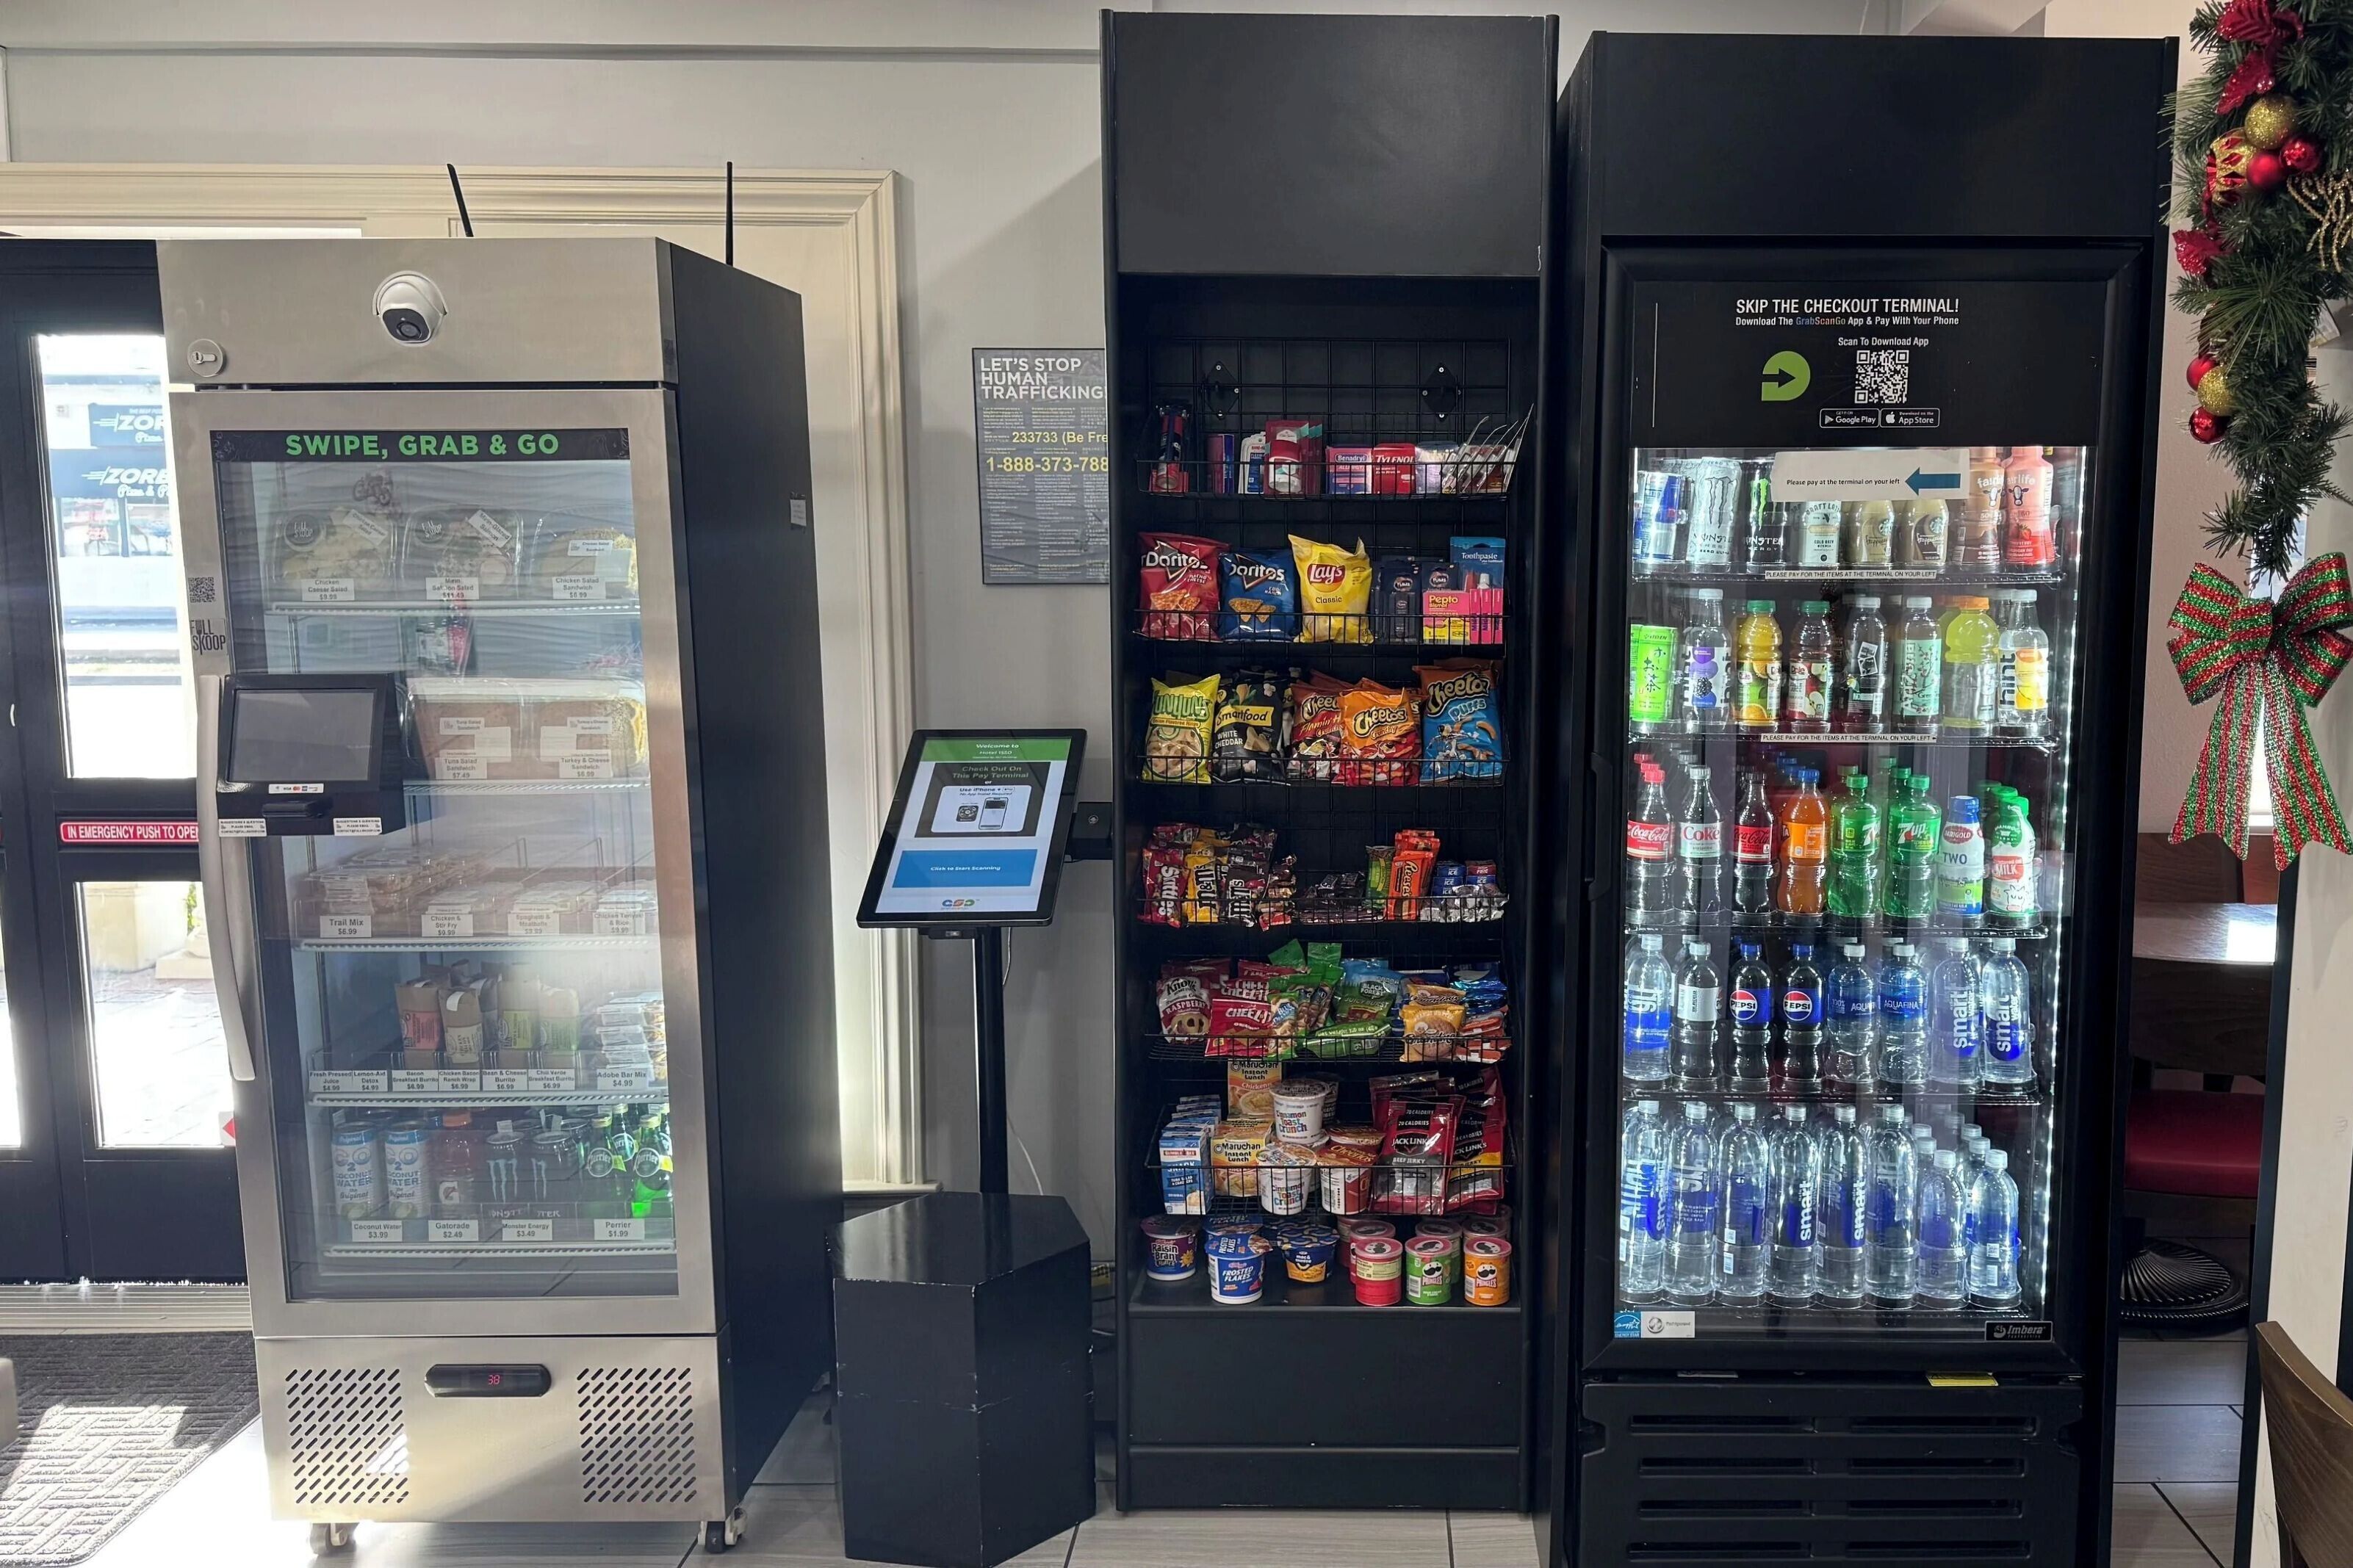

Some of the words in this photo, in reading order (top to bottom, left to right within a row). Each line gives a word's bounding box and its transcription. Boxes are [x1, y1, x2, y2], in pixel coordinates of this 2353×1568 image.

[1737, 300, 1768, 314] SKIP
[1773, 300, 1799, 313] THE
[1804, 299, 1878, 313] CHECKOUT
[1884, 298, 1959, 313] TERMINAL!
[1735, 317, 1776, 326] Download
[1779, 317, 1792, 326] The
[1795, 317, 1845, 326] GrabScanGo
[1848, 317, 1864, 328] App
[1875, 317, 1890, 328] Pay
[1892, 317, 1910, 325] With
[1913, 317, 1931, 325] Your
[1934, 317, 1959, 325] Phone
[1838, 338, 1857, 346] Scan
[1860, 338, 1869, 346] To
[1872, 337, 1911, 346] Download
[1913, 338, 1929, 347] App
[981, 358, 1028, 372] LET'S
[1034, 358, 1081, 372] STOP
[981, 372, 1048, 386] HUMAN
[1835, 416, 1861, 424] Google
[1862, 416, 1876, 424] Play
[1898, 417, 1914, 425] App
[1012, 432, 1058, 443] 233733
[1062, 432, 1084, 445] (Be
[286, 435, 389, 459] SWIPE,
[399, 434, 479, 455] GRAB
[489, 434, 507, 455] &
[517, 433, 559, 455] GO
[1337, 454, 1365, 463] Benadryl
[1462, 552, 1498, 561] Toothpaste
[1315, 595, 1343, 604] Classic
[1429, 595, 1458, 604] Pepto
[1791, 665, 1806, 674] Dole
[2000, 651, 2016, 705] hint
[1217, 711, 1269, 726] Smartfood
[1353, 708, 1407, 737] Cheetos
[1217, 730, 1238, 740] WHITE
[1371, 726, 1397, 740] Crunchy
[1215, 738, 1243, 749] CHEDDAR
[68, 825, 76, 839] IN
[79, 825, 135, 839] EMERGENCY
[137, 825, 161, 839] PUSH
[164, 825, 175, 839] TO
[1630, 824, 1669, 842] Coca-Cola
[1683, 825, 1720, 841] Coke
[1942, 852, 1967, 864] TWO
[1996, 865, 2017, 876] MILK
[329, 918, 348, 927] Trail
[350, 918, 364, 927] Mix
[1361, 988, 1384, 996] FOREST
[1363, 983, 1383, 991] BLACK
[1166, 1001, 1206, 1014] RASPBERRY
[1731, 1002, 1756, 1011] PEPSI
[1784, 1002, 1810, 1011] PEPSI
[1884, 1000, 1919, 1010] AQUAFINA
[1997, 995, 2011, 1052] smart
[1280, 1118, 1300, 1126] Toast
[1279, 1124, 1308, 1134] Crunch
[1407, 1157, 1425, 1165] JERKY
[1800, 1180, 1812, 1241] smart
[1854, 1180, 1866, 1240] smart
[354, 1222, 381, 1231] Coconut
[382, 1222, 403, 1231] Water
[435, 1221, 470, 1229] Gatorade
[502, 1222, 525, 1230] Monster
[527, 1222, 549, 1231] Energy
[605, 1221, 632, 1229] Perrier
[369, 1231, 389, 1239] $3.99
[443, 1230, 463, 1239] $2.49
[516, 1229, 536, 1238] $3.49
[608, 1229, 628, 1238] $1.99
[1152, 1243, 1178, 1253] Raisin
[1155, 1251, 1176, 1260] Bran
[1222, 1266, 1254, 1276] FROSTED
[1224, 1273, 1250, 1282] FLAKES
[2007, 1326, 2044, 1335] Imbera
